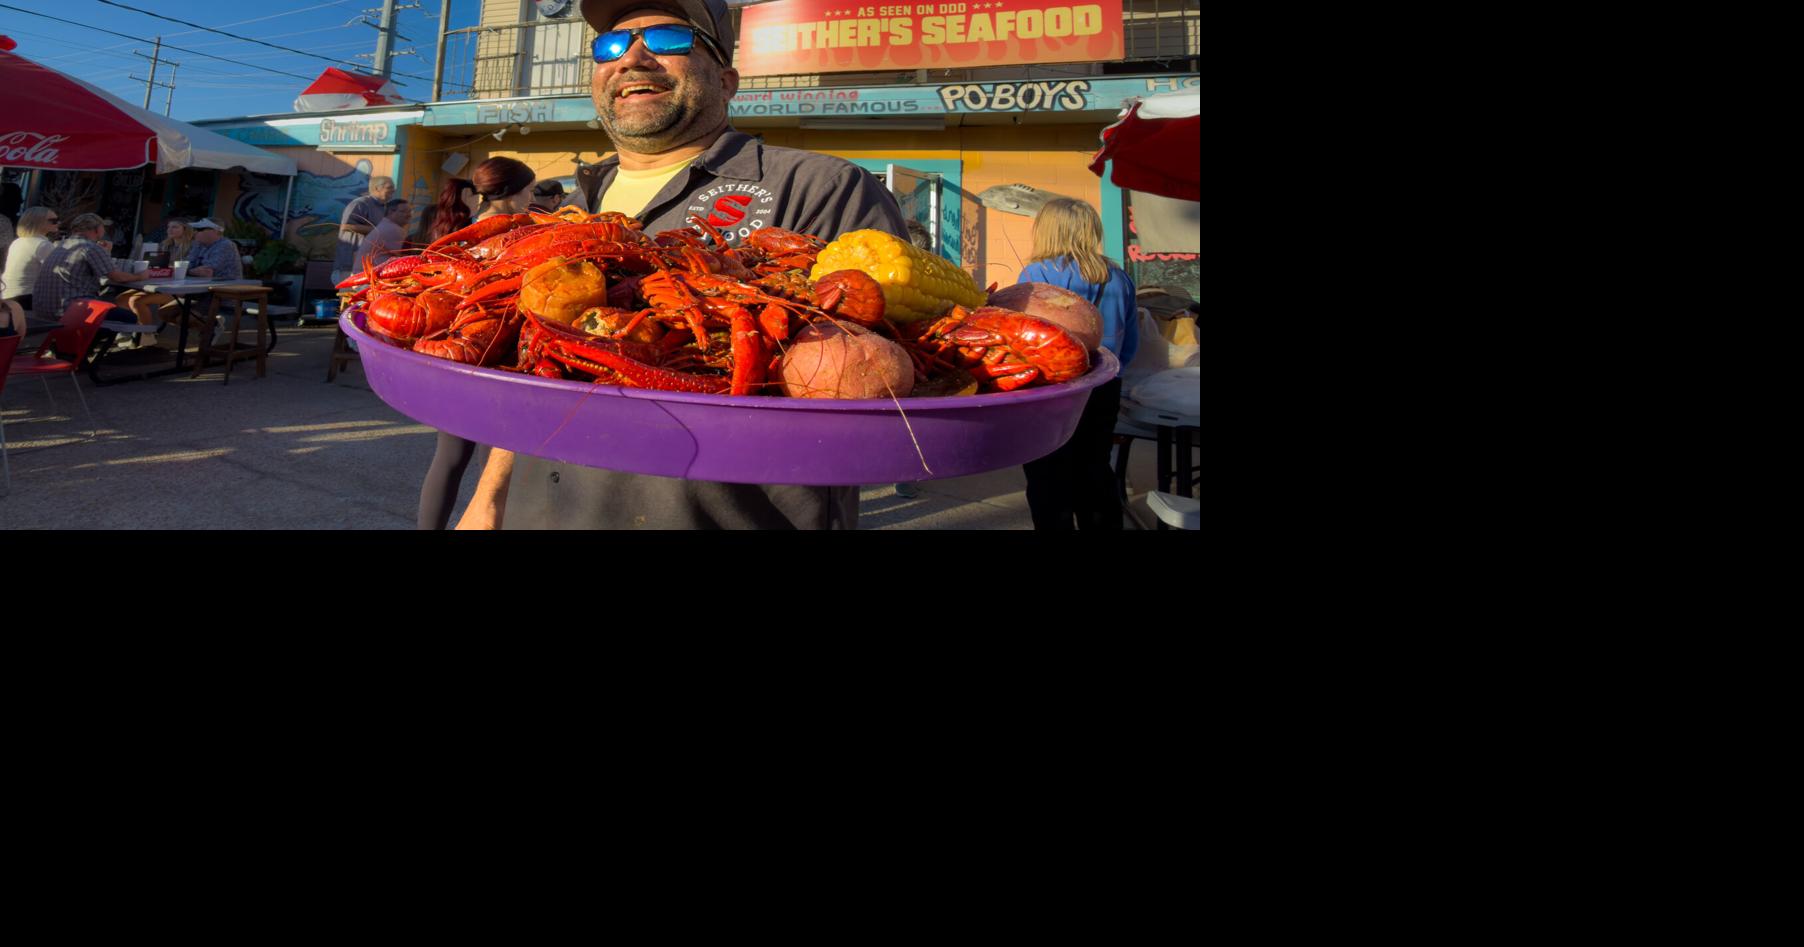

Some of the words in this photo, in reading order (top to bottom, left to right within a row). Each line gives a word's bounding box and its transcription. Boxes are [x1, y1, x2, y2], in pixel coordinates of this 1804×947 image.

[857, 6, 875, 17] AS
[880, 5, 912, 16] SEEN
[917, 4, 934, 15] ON
[939, 2, 967, 14] DDD
[921, 4, 1102, 45] SEAFOOD
[780, 89, 859, 104] winning
[938, 80, 1091, 111] PO-BOYS
[477, 101, 554, 124] FISH
[730, 103, 815, 115] WORLD
[822, 100, 919, 114] FAMOUS
[320, 118, 388, 145] Shrimp
[698, 183, 773, 204] SEITHER'S
